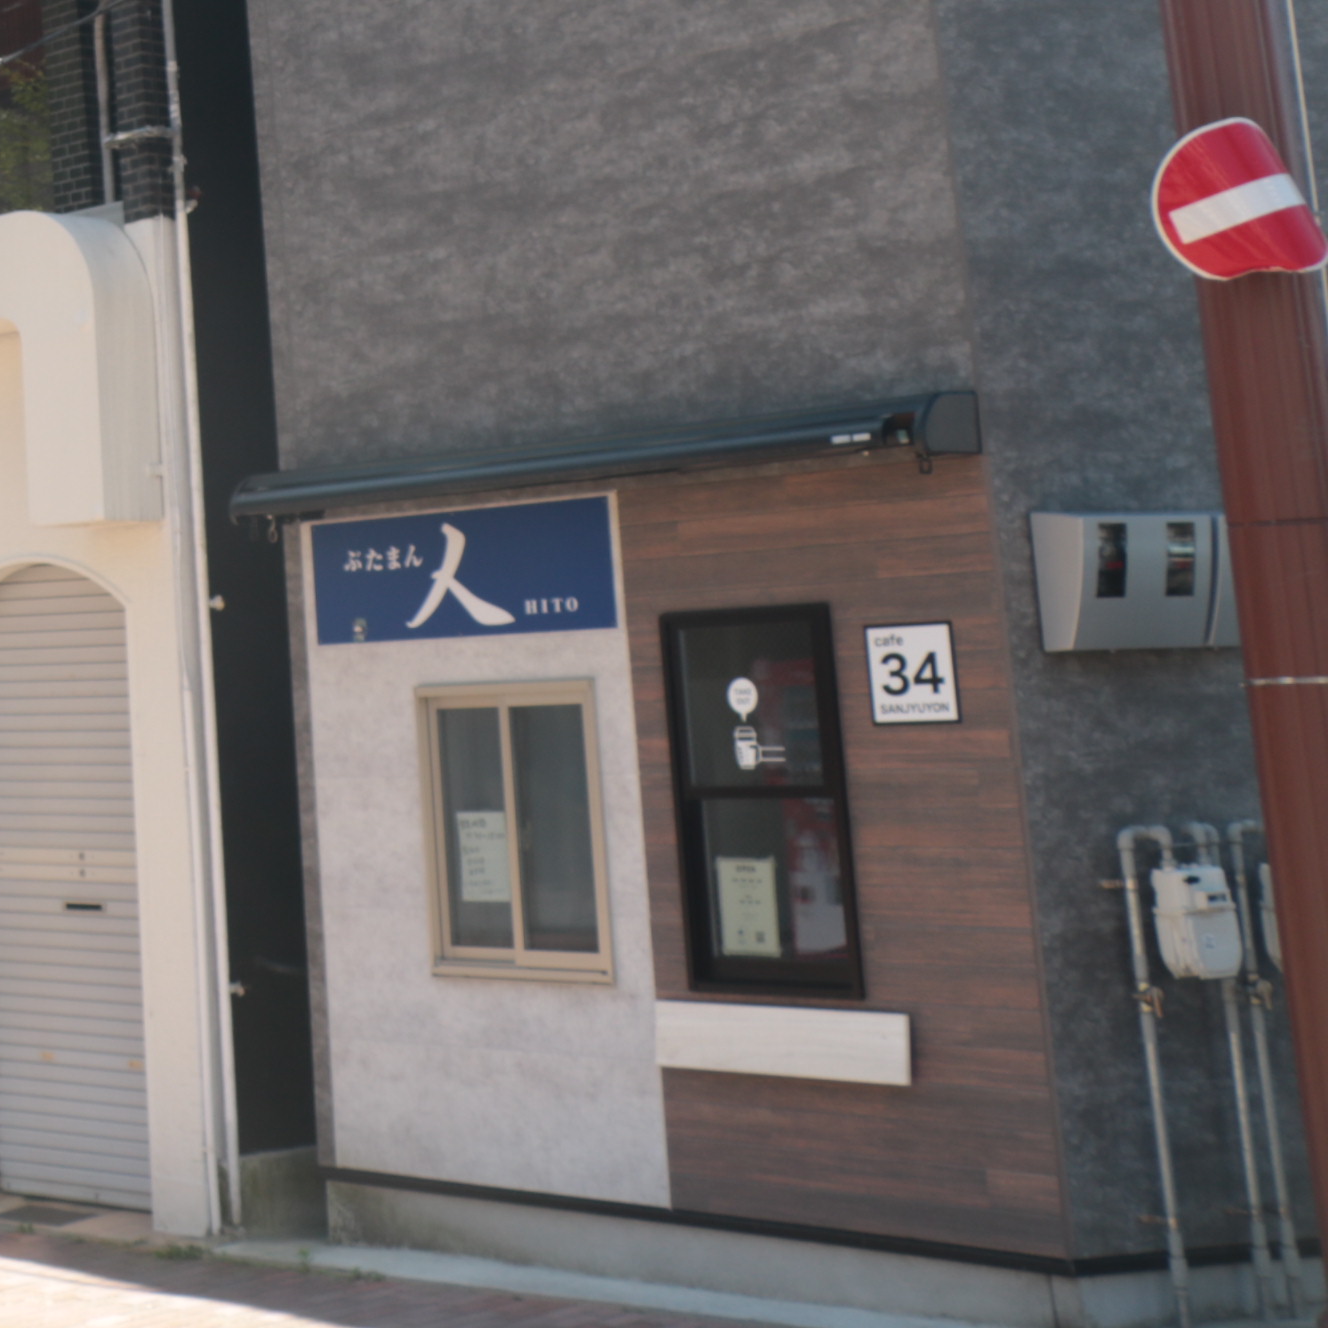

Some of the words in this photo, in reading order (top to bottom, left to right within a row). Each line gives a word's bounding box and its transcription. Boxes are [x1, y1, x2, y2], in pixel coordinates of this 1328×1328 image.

[343, 544, 424, 572] ぶたまん
[405, 522, 516, 629] 人
[524, 596, 579, 615] HITO
[874, 634, 904, 647] cafe
[880, 651, 946, 697] 34
[880, 702, 950, 714] SANJYUYON
